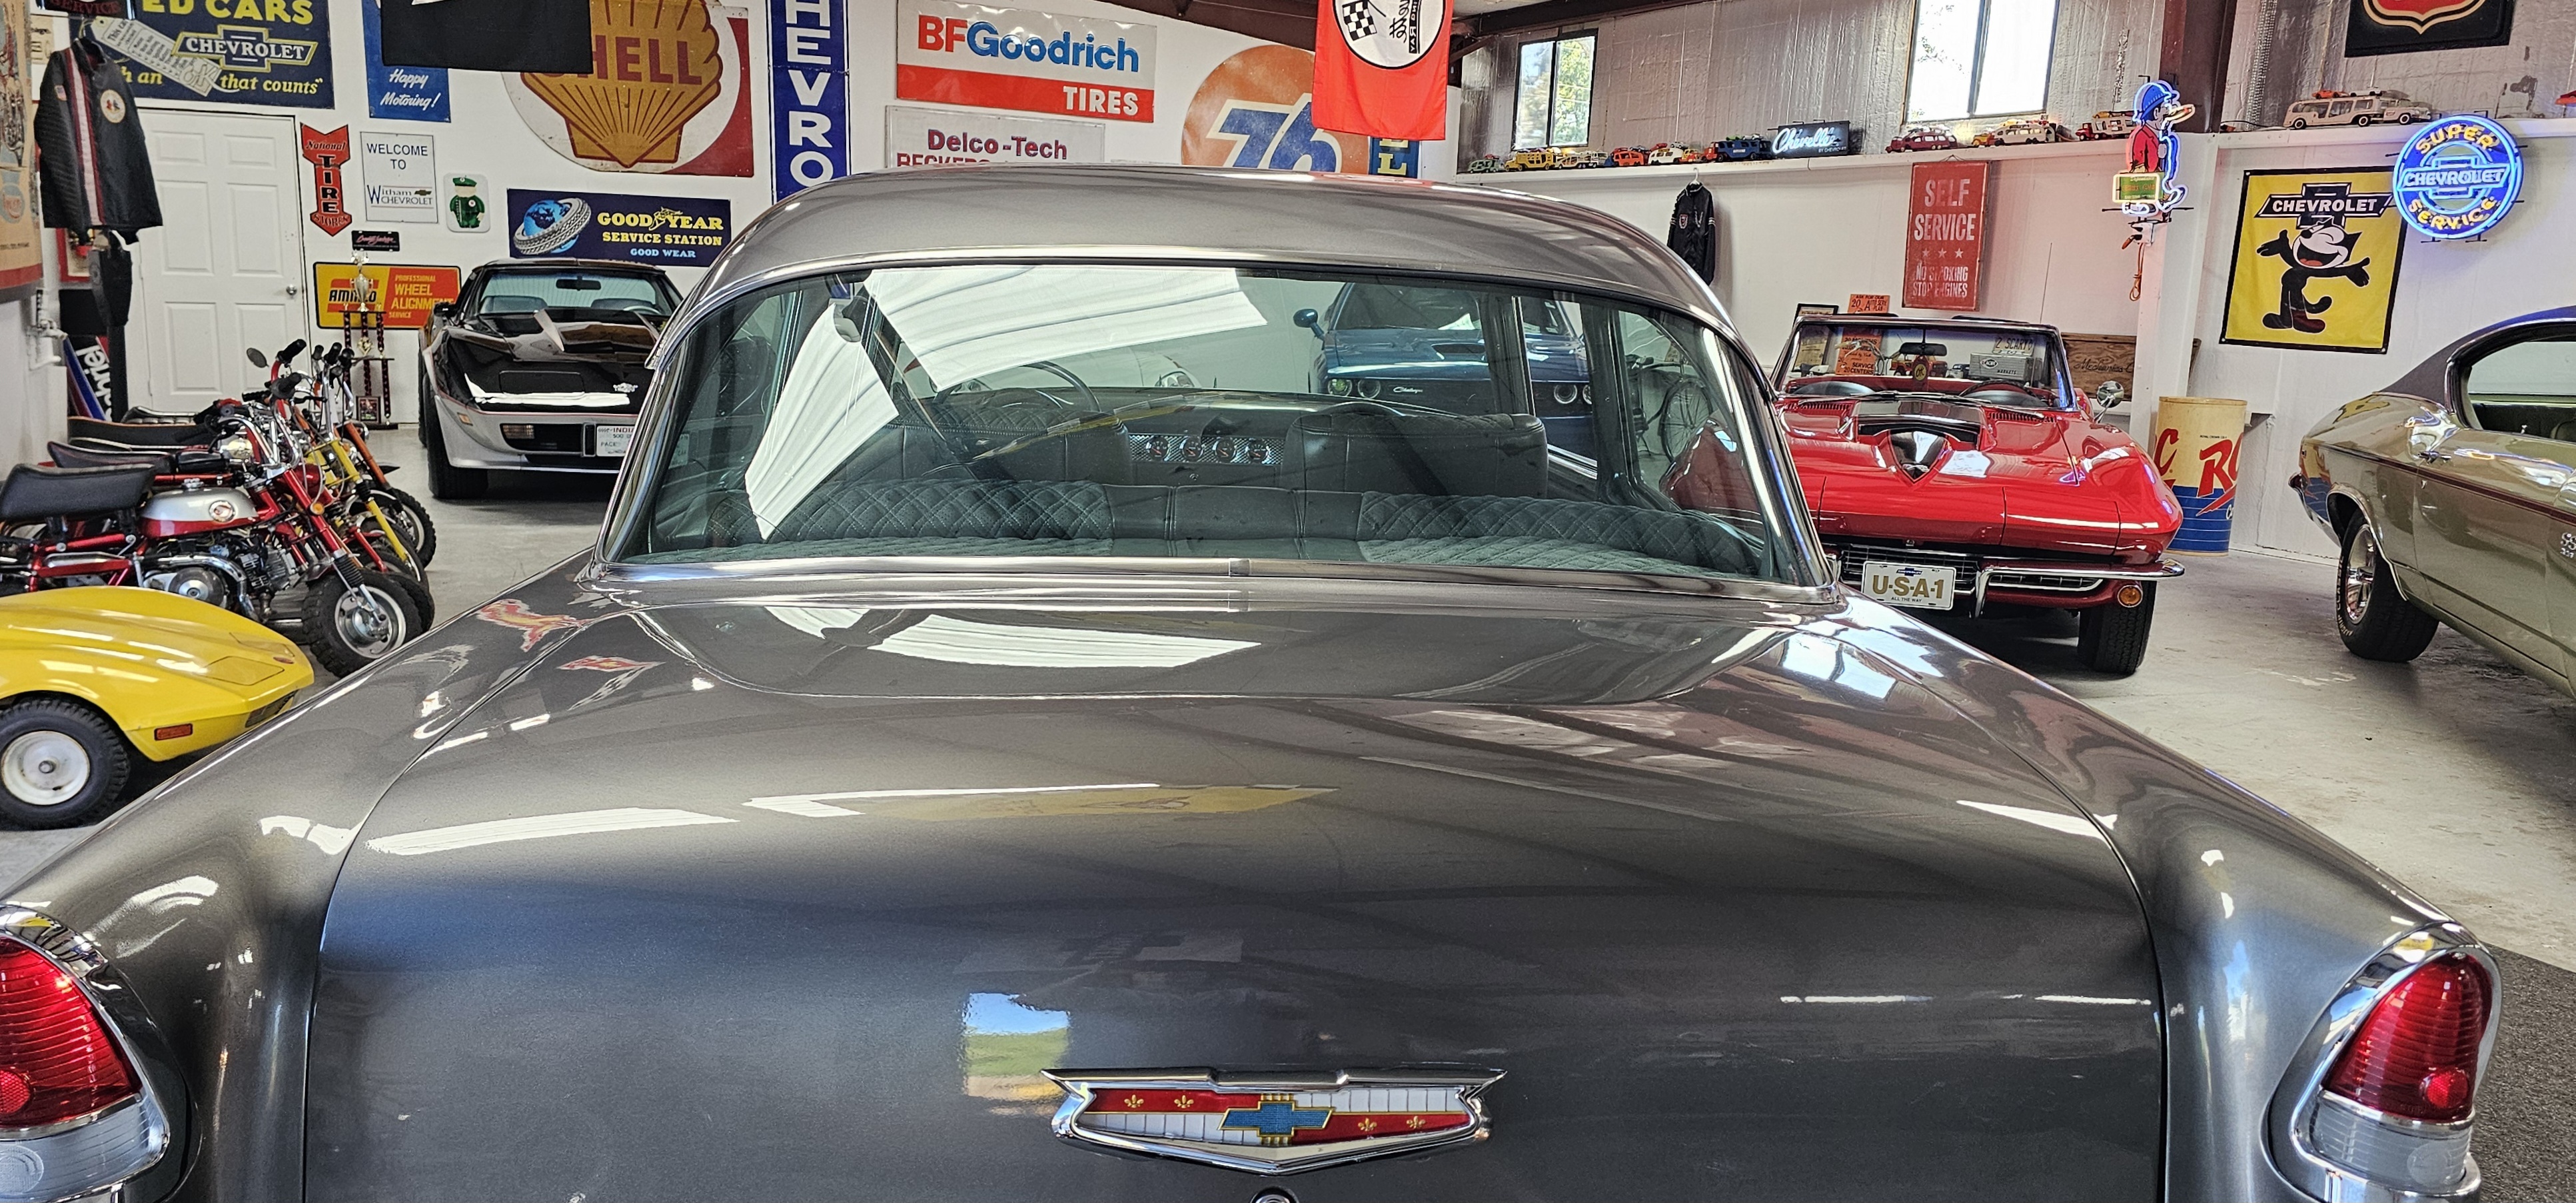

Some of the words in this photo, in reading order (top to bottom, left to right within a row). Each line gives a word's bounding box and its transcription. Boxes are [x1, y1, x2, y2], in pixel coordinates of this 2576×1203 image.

[205, 0, 313, 25] CARS
[186, 37, 304, 59] CHEVROLET
[918, 14, 1139, 73] BFGoodrich
[542, 35, 702, 85] HELL
[137, 71, 163, 85] an
[220, 73, 258, 91] that
[389, 69, 428, 89] Happy
[380, 92, 440, 111] Motoring!
[1063, 85, 1139, 116] TIRES
[306, 139, 346, 151] National
[1772, 127, 1840, 154] Chevelle
[2416, 124, 2500, 154] SUPER
[366, 143, 428, 156] WELCOME
[390, 159, 406, 169] TO
[318, 155, 338, 213] TIRE
[2404, 169, 2505, 187] CHEVROLET
[366, 185, 412, 204] Witham
[380, 196, 432, 205] CHEVROLET
[1925, 179, 1970, 207] SELF
[2272, 199, 2377, 212] CHEVROLET
[2408, 196, 2501, 231] SERVICE
[313, 211, 348, 227] STORES
[1914, 213, 1976, 241] SERVICE
[602, 231, 660, 243] SERVICE
[664, 234, 722, 246] STATION
[630, 248, 659, 257] GOOD
[664, 249, 696, 258] WEAR
[394, 283, 433, 296] WHEEL
[1851, 299, 1861, 307] 20
[1916, 368, 1926, 377] OK
